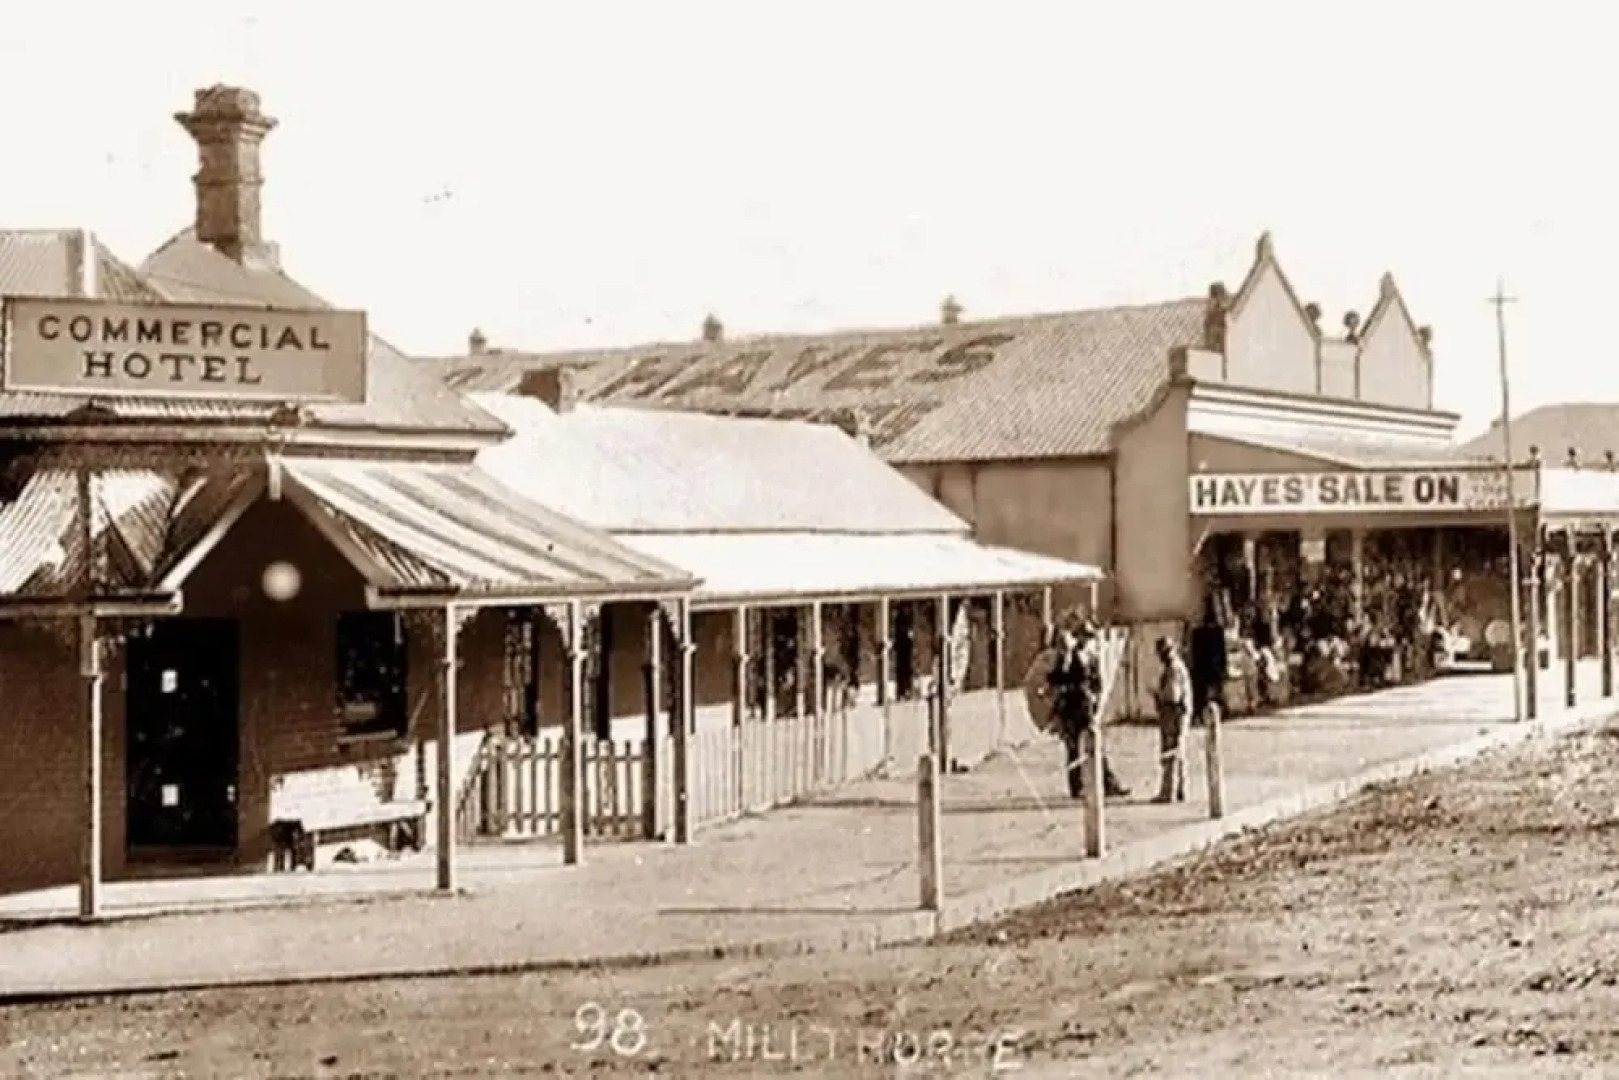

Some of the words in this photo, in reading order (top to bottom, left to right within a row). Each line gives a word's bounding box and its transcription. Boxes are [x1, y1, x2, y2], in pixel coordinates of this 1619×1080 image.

[38, 314, 331, 350] COMMERCIAL
[83, 351, 262, 385] HOTEL
[588, 331, 1016, 402] HAYES
[1317, 475, 1402, 504] SALE
[1413, 475, 1460, 503] ON
